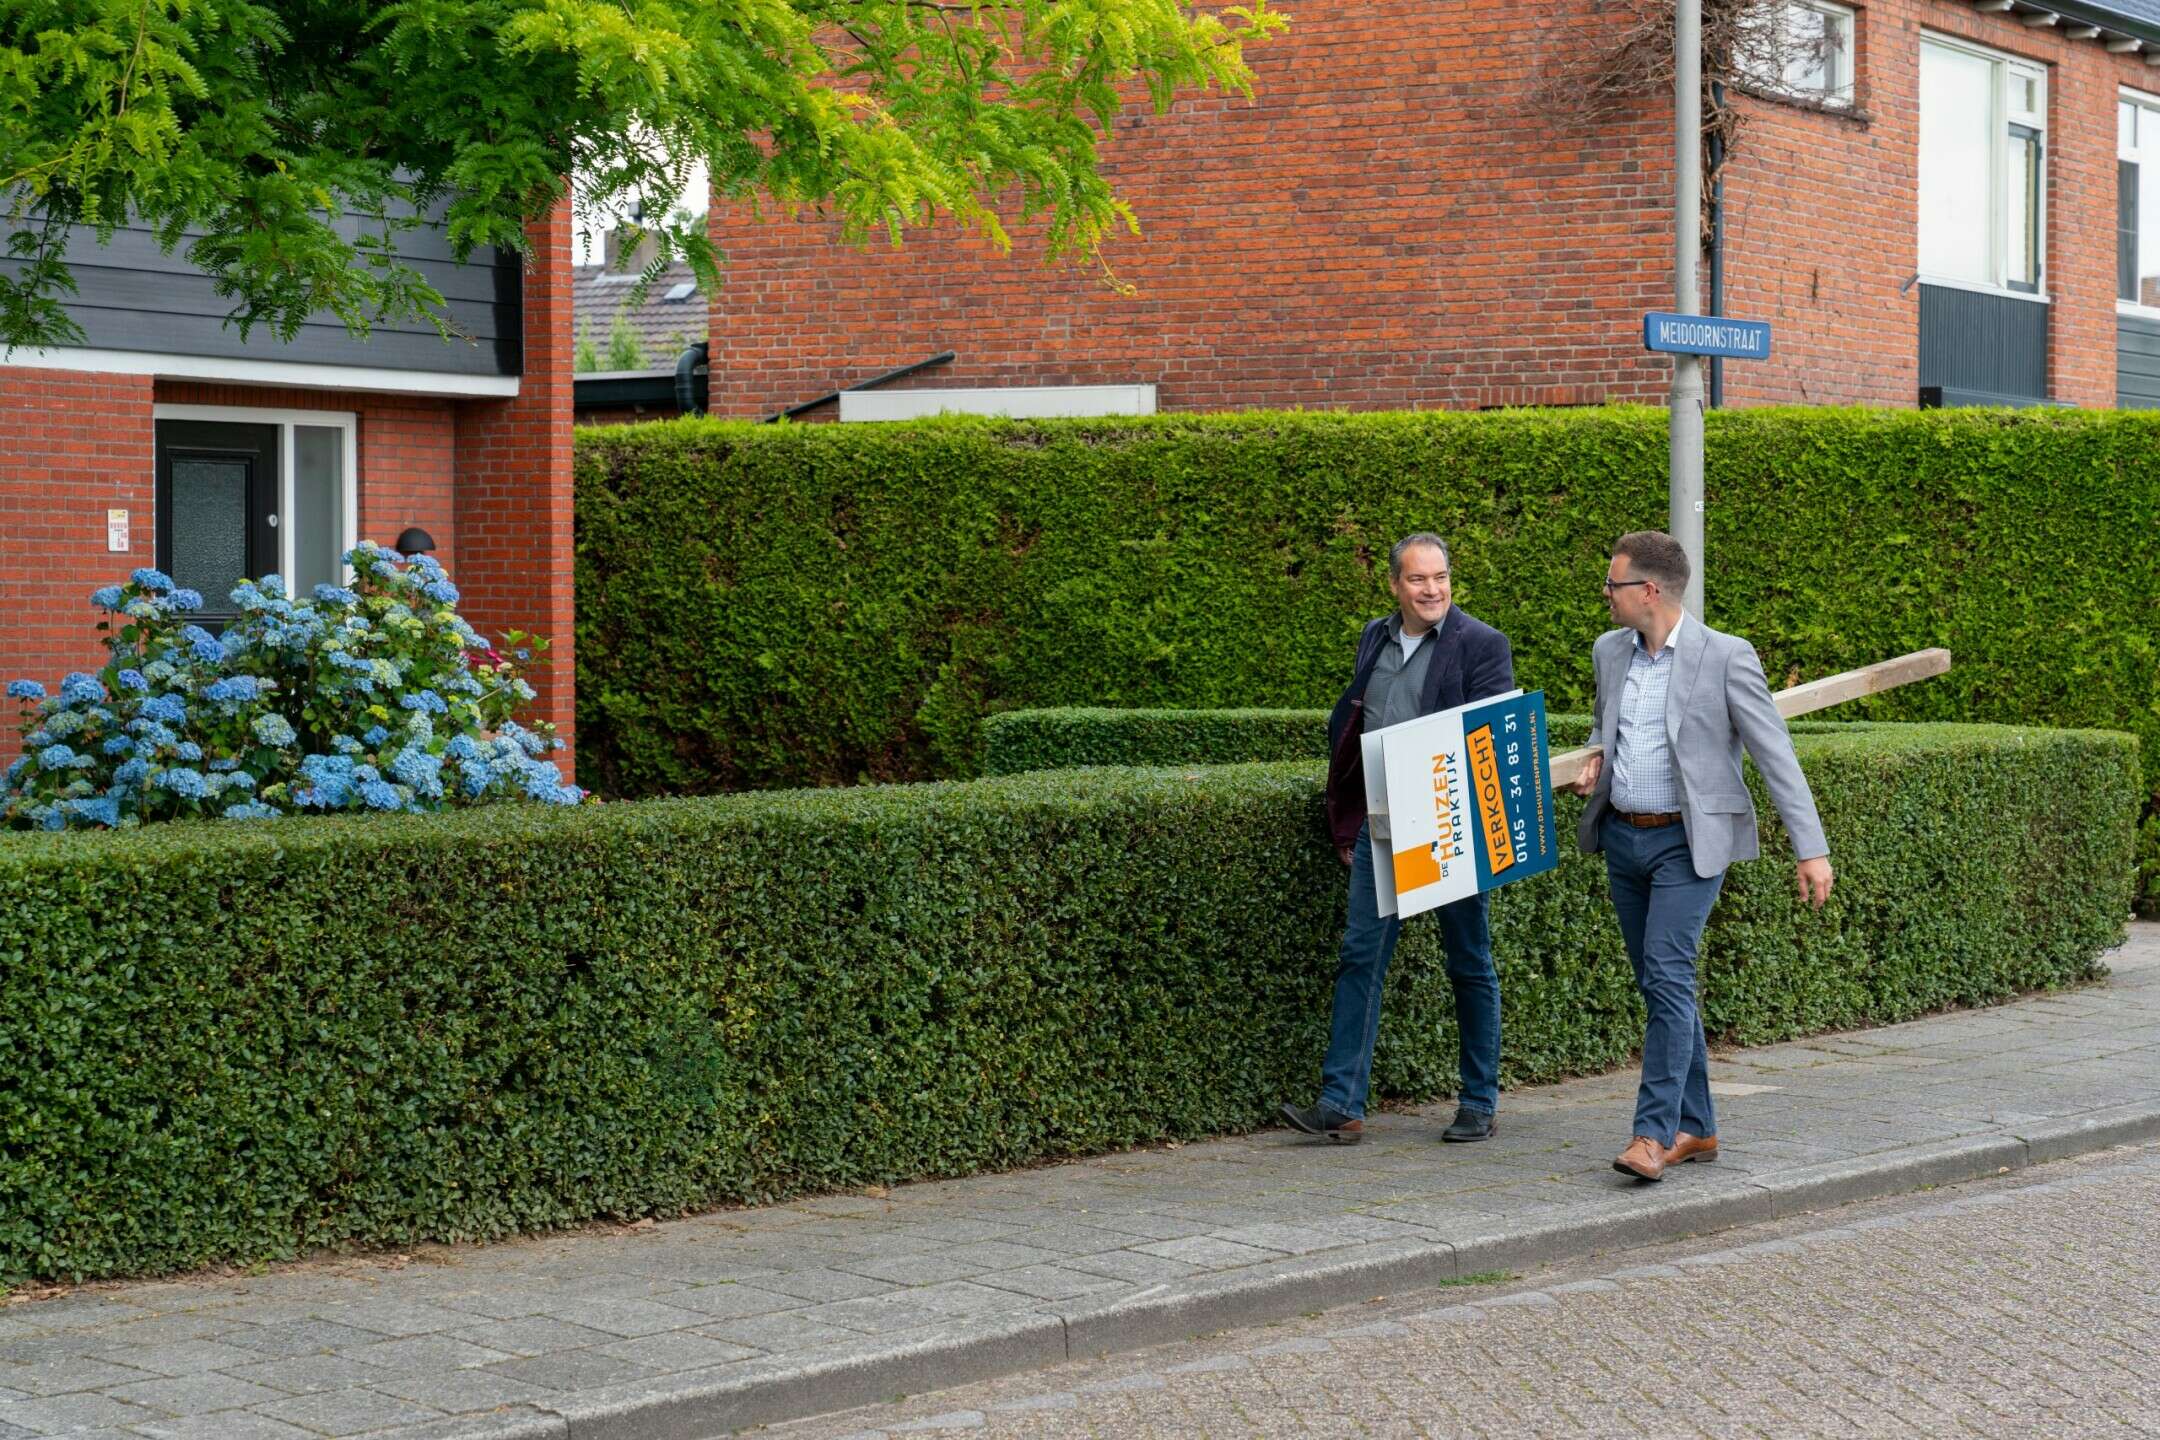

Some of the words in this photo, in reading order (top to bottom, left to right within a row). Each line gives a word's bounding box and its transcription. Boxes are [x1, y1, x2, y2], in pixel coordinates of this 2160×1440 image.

[1660, 321, 1762, 351] MEIDOORNSTRAAT
[1505, 713, 1516, 733] 31
[1507, 742, 1519, 766] 85
[1474, 735, 1507, 866] VERKOCHT
[1510, 774, 1522, 798] 34
[1527, 709, 1546, 856] WWW.DEHUIZENPRAKTIJK.NL
[1432, 753, 1456, 861] HUIZEN
[1446, 751, 1464, 857] PRAKTIJK
[1513, 818, 1528, 863] 0165
[1442, 862, 1449, 878] DE
